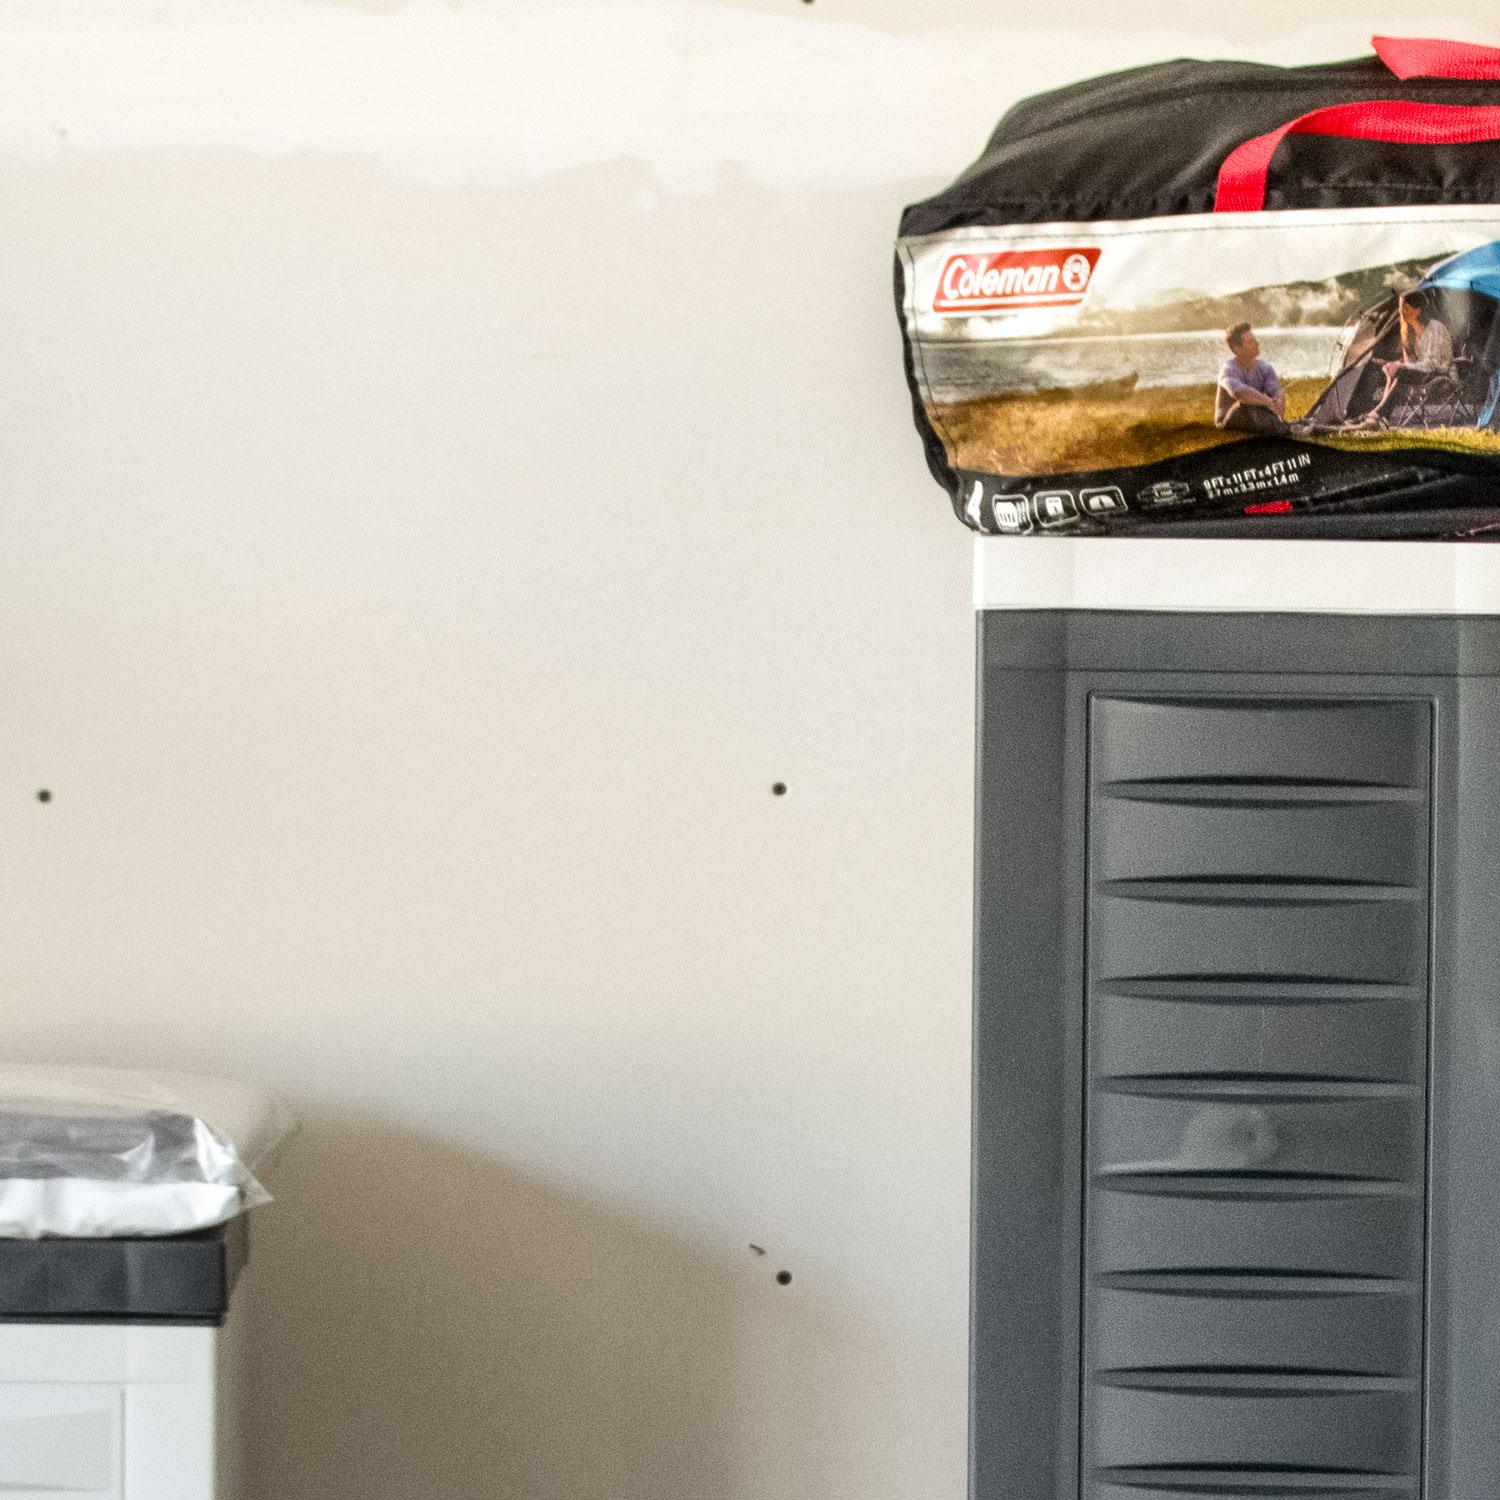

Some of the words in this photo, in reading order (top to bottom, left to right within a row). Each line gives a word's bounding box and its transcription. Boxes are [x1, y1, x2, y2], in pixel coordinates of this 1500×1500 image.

[944, 258, 1060, 299] Coleman
[1211, 476, 1225, 488] FT
[1232, 473, 1243, 483] 11
[1244, 468, 1257, 482] FT
[1264, 464, 1271, 476] 4
[1272, 461, 1285, 474] FT
[1286, 458, 1297, 471] 11
[1298, 453, 1311, 467] IN
[1256, 480, 1266, 489] m
[1273, 474, 1287, 486] 1.4
[1288, 473, 1299, 483] m
